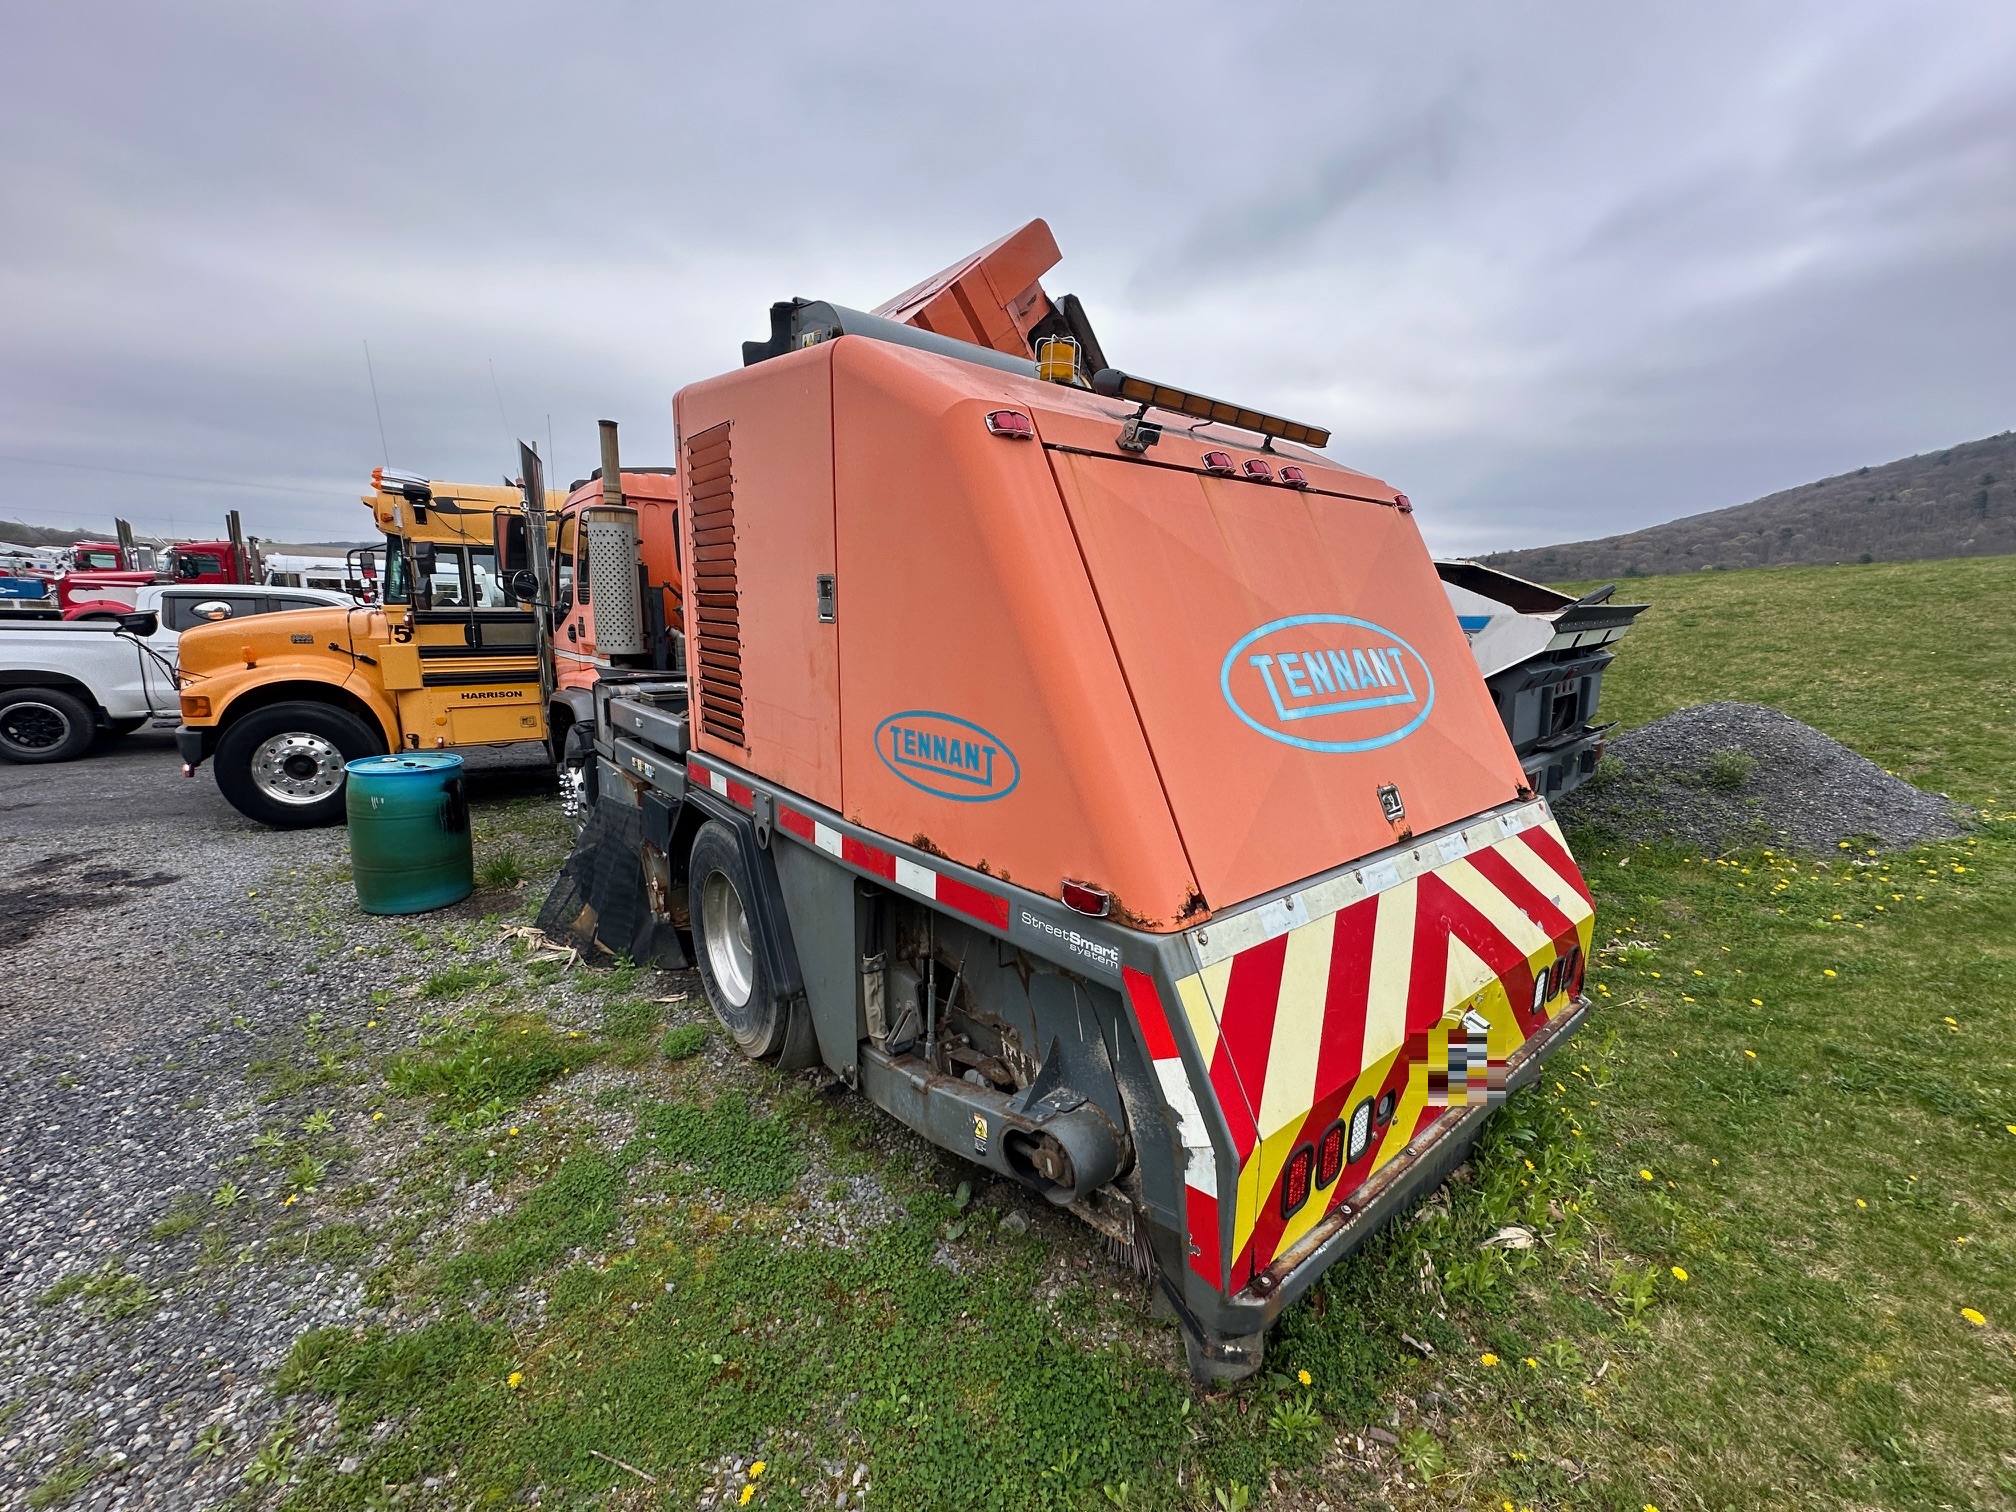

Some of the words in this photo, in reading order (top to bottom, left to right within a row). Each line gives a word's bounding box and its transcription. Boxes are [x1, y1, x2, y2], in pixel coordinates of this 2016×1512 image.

[461, 691, 523, 699] HARRISON
[1249, 646, 1417, 721] TENNANT
[889, 726, 997, 787] TENNANT
[1069, 943, 1118, 969] system
